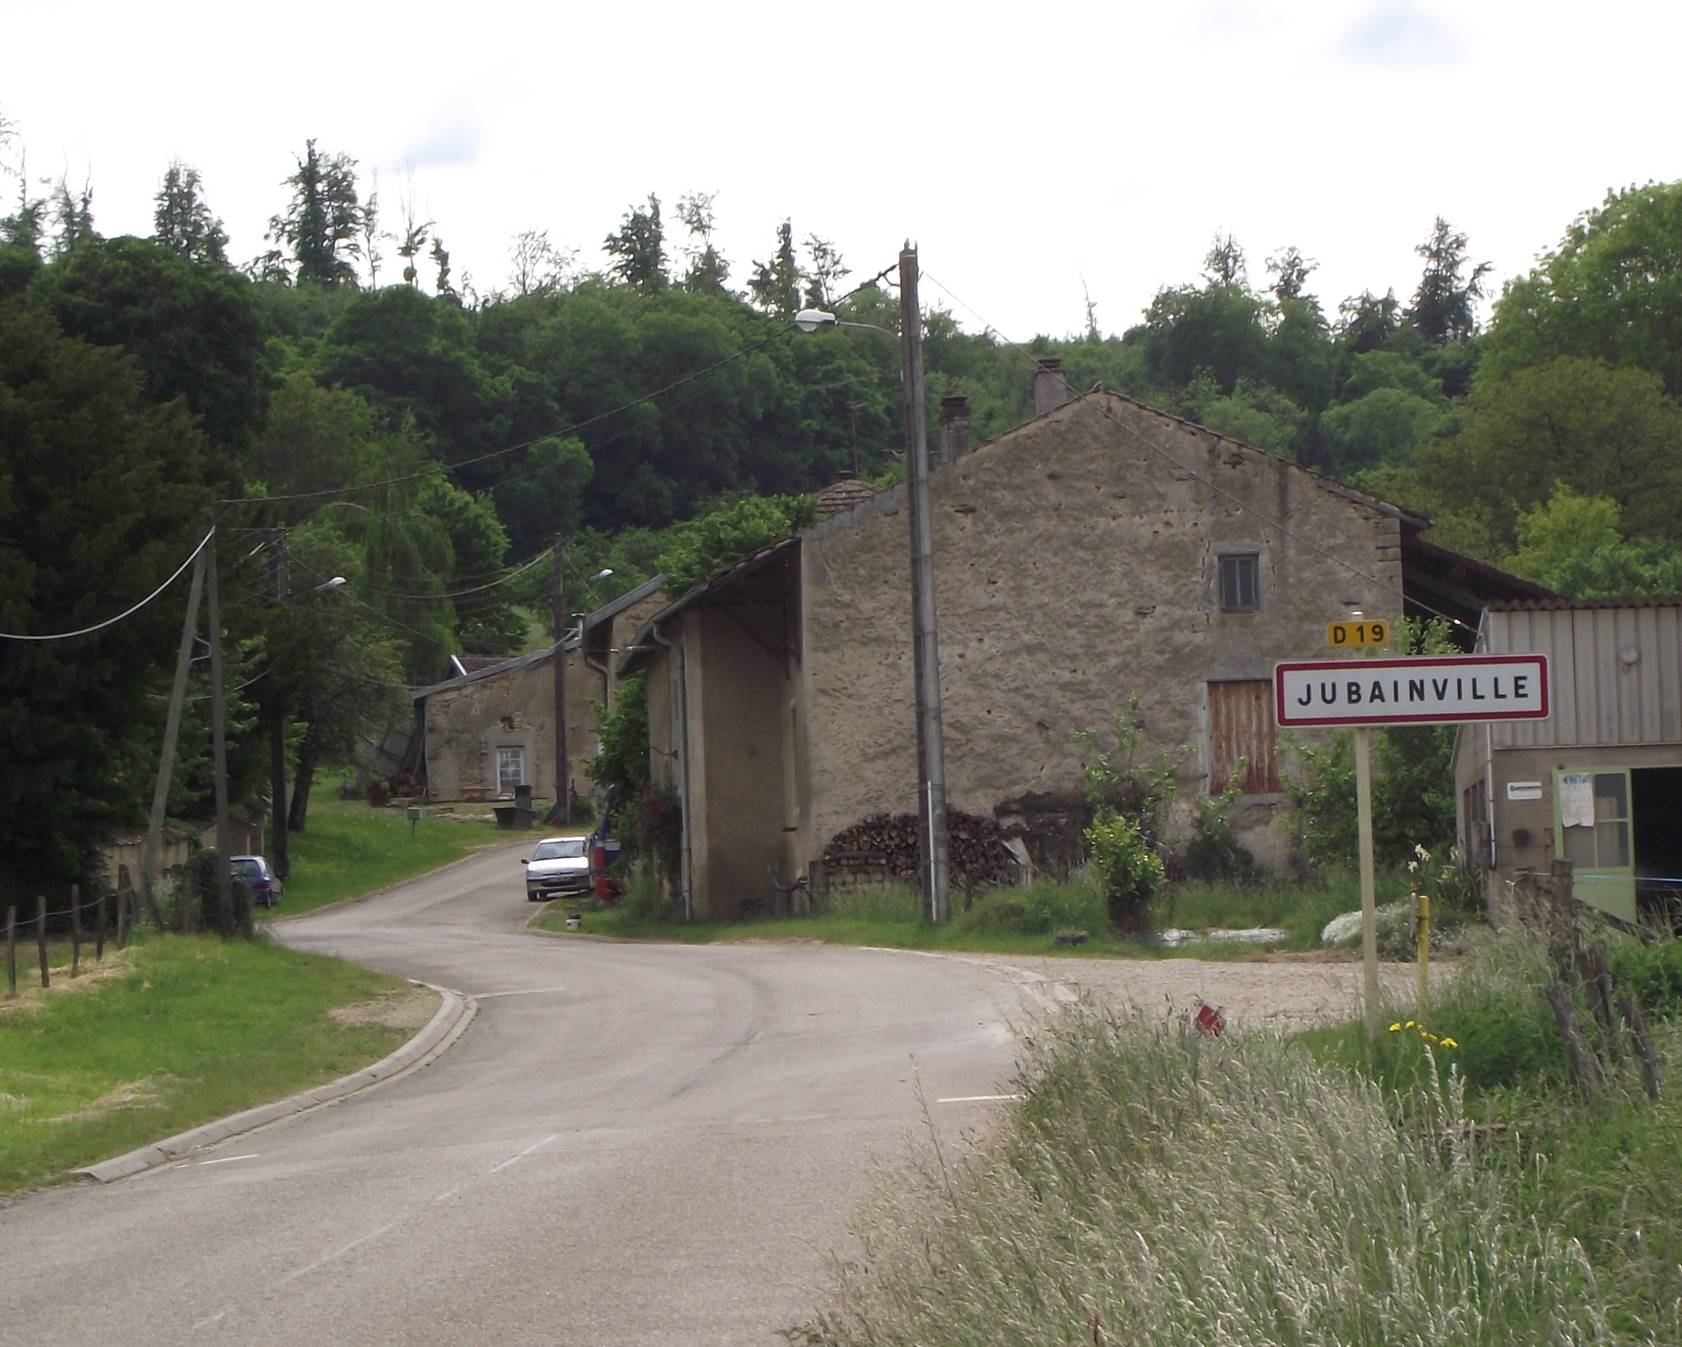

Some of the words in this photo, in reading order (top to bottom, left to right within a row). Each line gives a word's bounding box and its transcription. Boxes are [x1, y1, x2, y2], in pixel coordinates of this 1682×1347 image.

[1332, 625, 1347, 644] D
[1355, 624, 1385, 643] 19
[1297, 675, 1529, 706] JUBAINVILLE
